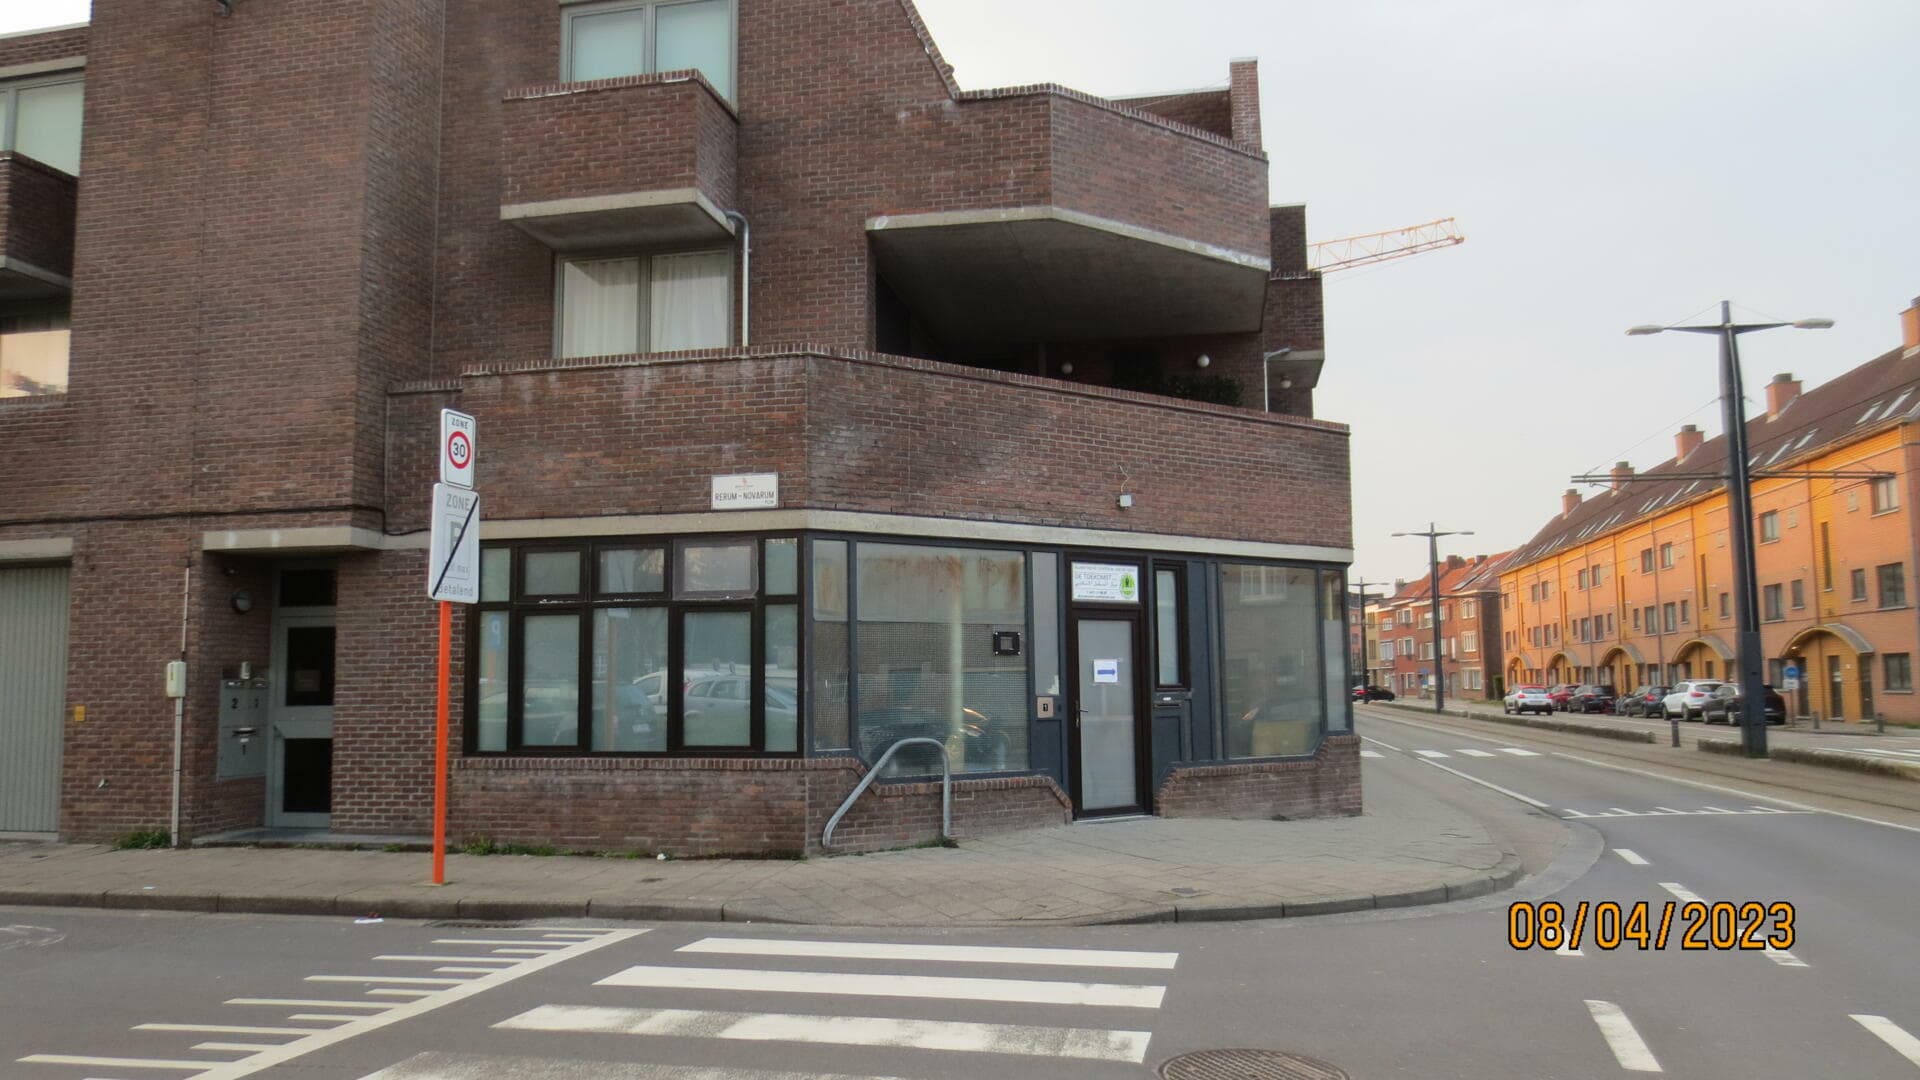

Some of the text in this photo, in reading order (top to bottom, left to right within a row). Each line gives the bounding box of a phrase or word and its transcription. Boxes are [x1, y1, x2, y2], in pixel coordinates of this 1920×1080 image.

[451, 417, 469, 430] ZONE
[453, 442, 465, 458] 30
[446, 493, 471, 511] ZONE
